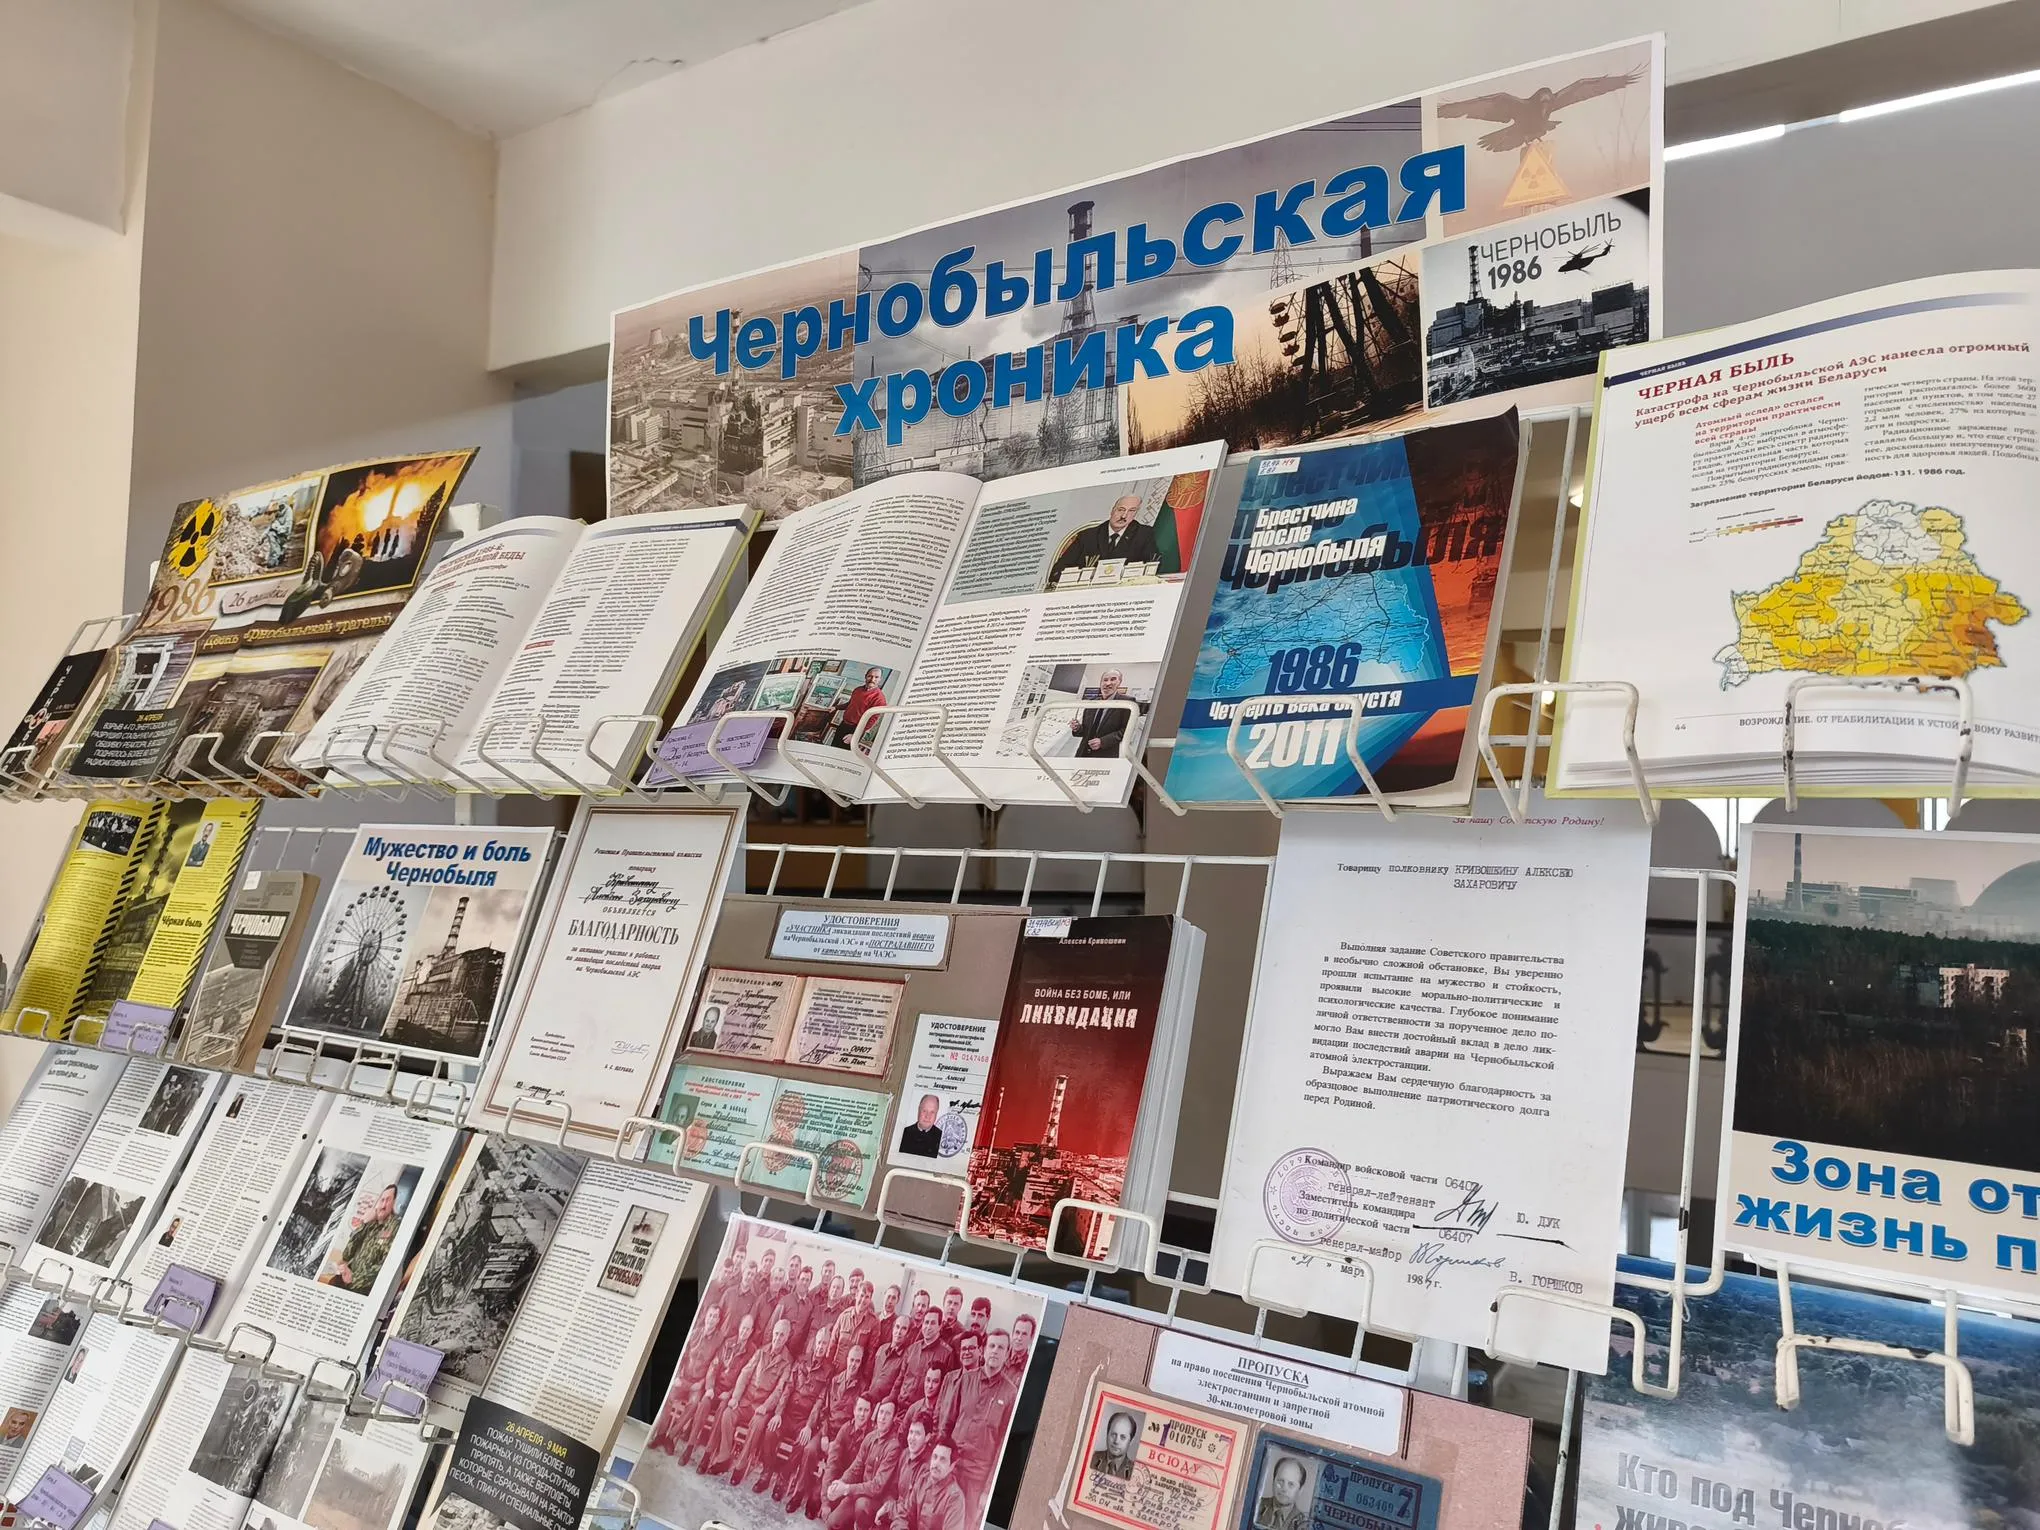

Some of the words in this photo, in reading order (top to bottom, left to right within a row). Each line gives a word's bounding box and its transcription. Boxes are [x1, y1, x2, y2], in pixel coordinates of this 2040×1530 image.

[1481, 211, 1622, 264] ЧЕРНОБЫЛЬ
[687, 144, 1466, 378] Чернобыльская
[1488, 255, 1542, 290] 1986
[833, 305, 1236, 447] хроника
[1635, 393, 1709, 417] Катастрофа
[1712, 389, 1729, 398] на
[1731, 360, 1844, 393] Чернобыльской
[1848, 354, 1877, 368] АЭС
[1880, 346, 1944, 362] нанесла
[1948, 342, 2030, 354] огромный
[1638, 370, 1722, 400] ЧЕРНАЯ
[1729, 352, 1795, 379] БЫЛЬ
[1634, 409, 1675, 430] ущерб
[1678, 403, 1709, 417] всем
[1712, 390, 1763, 409] сферам
[1766, 379, 1814, 396] жизни
[1817, 365, 1887, 384] Беларуси
[1694, 429, 1707, 437] на
[1709, 415, 1769, 434] территории
[1771, 400, 1841, 420] практически
[1695, 412, 1742, 429] Атомный
[1744, 404, 1781, 417] «след»
[1782, 395, 1824, 409] остался
[1694, 434, 1717, 445] всей
[1718, 426, 1757, 439] страны
[1689, 492, 1747, 509] Загрязнение
[1748, 482, 1806, 497] территории
[1807, 475, 1854, 487] Беларуси
[1855, 469, 1915, 481] йодом-131.
[1918, 467, 1943, 475] 1986
[1256, 497, 1359, 531] Брестчина
[1250, 525, 1313, 549] после
[1244, 535, 1388, 577] Чернобыля
[1264, 641, 1364, 695] 1986
[1209, 700, 1284, 721] Четерть
[1739, 715, 1814, 728] ВОЗРОЖДИЕ.
[1816, 715, 1829, 724] ОТ
[1830, 715, 1916, 726] РЕАБИЛИТАЦИИ
[1917, 718, 1925, 727] К
[1928, 718, 2002, 736] УСТОЙВОМУ
[1245, 718, 1346, 769] 2011
[1469, 816, 1494, 827] нашу
[1562, 815, 1605, 828] Родину!
[362, 836, 458, 862] Мужество
[462, 845, 476, 860] и
[482, 839, 532, 863] боль
[385, 861, 499, 888] Чернобыля
[1336, 862, 1381, 874] Товарищу
[1388, 864, 1449, 876] полковнику
[1453, 878, 1518, 891] ЗАХАРОВИЧУ
[567, 919, 680, 945] БЛАГОДАРНОСТЬ
[823, 914, 901, 929] УДОСТОВЕРЕНИЯ
[1059, 937, 1087, 945] Алексей
[1087, 937, 1127, 947] Кривошеин
[1339, 941, 1387, 953] Выполняя
[1389, 946, 1426, 956] задание
[1428, 947, 1487, 960] Советского
[1489, 953, 1565, 965] правительства
[1333, 955, 1379, 966] необычно
[1382, 960, 1425, 970] сложной
[1427, 961, 1488, 975] обстановке,
[1492, 965, 1510, 976] Вы
[1514, 969, 1564, 980] уверенно
[1034, 986, 1063, 998] ВОЙНА
[1064, 989, 1082, 999] БЕЗ
[1083, 989, 1110, 1001] БОМБ,
[1112, 990, 1131, 1000] ИЛИ
[931, 1021, 987, 1033] УДОСТОВЕРЕНИЕ
[1020, 1004, 1138, 1030] ЛИКВИДАЦИЯ
[1321, 1065, 1373, 1080] Выражаем
[1376, 1071, 1397, 1083] Вам
[1400, 1076, 1455, 1090] сердечную
[1458, 1081, 1536, 1099] благодарность
[1539, 1093, 1552, 1102] за
[1303, 1093, 1330, 1105] перед
[1332, 1095, 1376, 1110] Родиной.
[1303, 1154, 1352, 1174] Командир
[1354, 1164, 1406, 1180] войсковой
[1409, 1173, 1438, 1185] части
[1770, 1139, 1942, 1204] Зона
[1299, 1189, 1359, 1210] Заместитель
[1362, 1203, 1416, 1221] командира
[1327, 1181, 1436, 1209] генерал-лейтенант
[1295, 1206, 1309, 1216] по
[1311, 1209, 1379, 1229] политической
[1382, 1222, 1411, 1234] части
[1517, 1211, 1530, 1225] Ю.
[1537, 1215, 1561, 1230] ДУК
[1732, 1194, 1969, 1262] жизнь
[1319, 1236, 1403, 1262] генерал-майор
[1438, 1228, 1473, 1244] 06407
[1509, 1270, 1523, 1284] В.
[1531, 1275, 1584, 1295] ГОРШКОВ
[1237, 1356, 1310, 1385] ПРОПУСКА
[1170, 1358, 1182, 1368] на
[1183, 1361, 1210, 1375] право
[1212, 1368, 1263, 1388] посещения
[1265, 1379, 1340, 1408] Чернобыльской
[1342, 1399, 1385, 1418] атомной
[1197, 1378, 1271, 1404] электростанции
[1273, 1398, 1280, 1407] и
[1282, 1400, 1330, 1420] запретной
[1206, 1393, 1287, 1424] 30-километровой
[1289, 1417, 1313, 1430] зоны
[505, 1421, 515, 1432] 26
[516, 1426, 544, 1446] АПРЕЛЯ
[1169, 1419, 1208, 1440] ПРОПУСК
[470, 1434, 512, 1460] ПОЖАРНЫХ
[512, 1452, 523, 1466] ИЗ
[486, 1426, 514, 1446] ПОЖАР
[514, 1438, 543, 1460] ТУШИЛИ
[542, 1452, 564, 1472] БОЛЕЕ
[565, 1466, 576, 1479] 100
[1148, 1449, 1201, 1474] ВСЮДУ
[1351, 1471, 1395, 1494] ПРОПУСК
[1617, 1451, 1678, 1500] Кто
[1690, 1475, 1756, 1526] под
